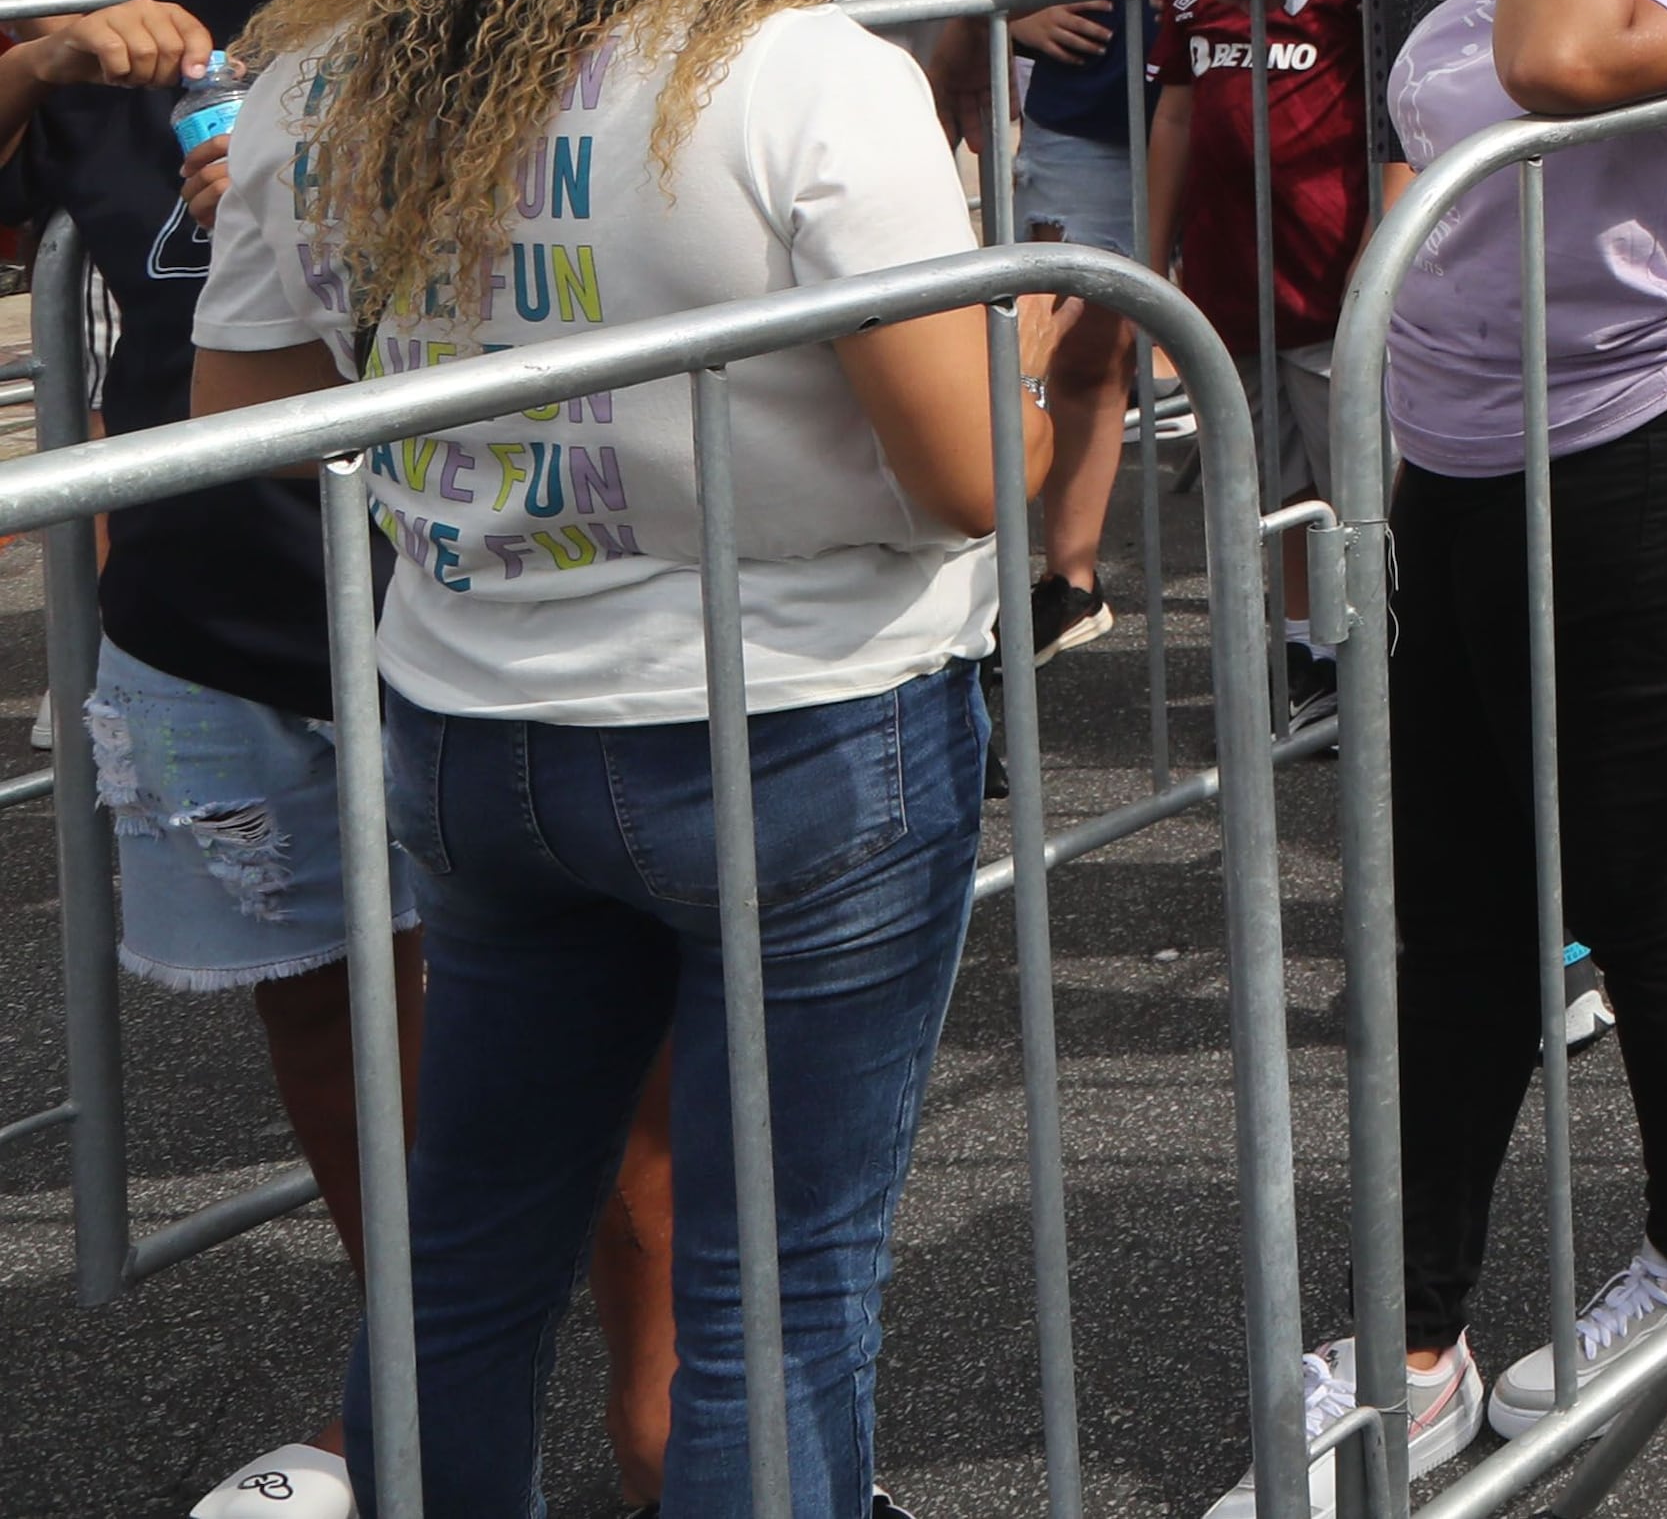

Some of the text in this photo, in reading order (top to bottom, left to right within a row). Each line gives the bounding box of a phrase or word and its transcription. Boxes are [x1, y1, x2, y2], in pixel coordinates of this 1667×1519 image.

[1211, 42, 1318, 71] BETNO
[487, 441, 628, 518] FUN
[484, 523, 648, 580] FUN
